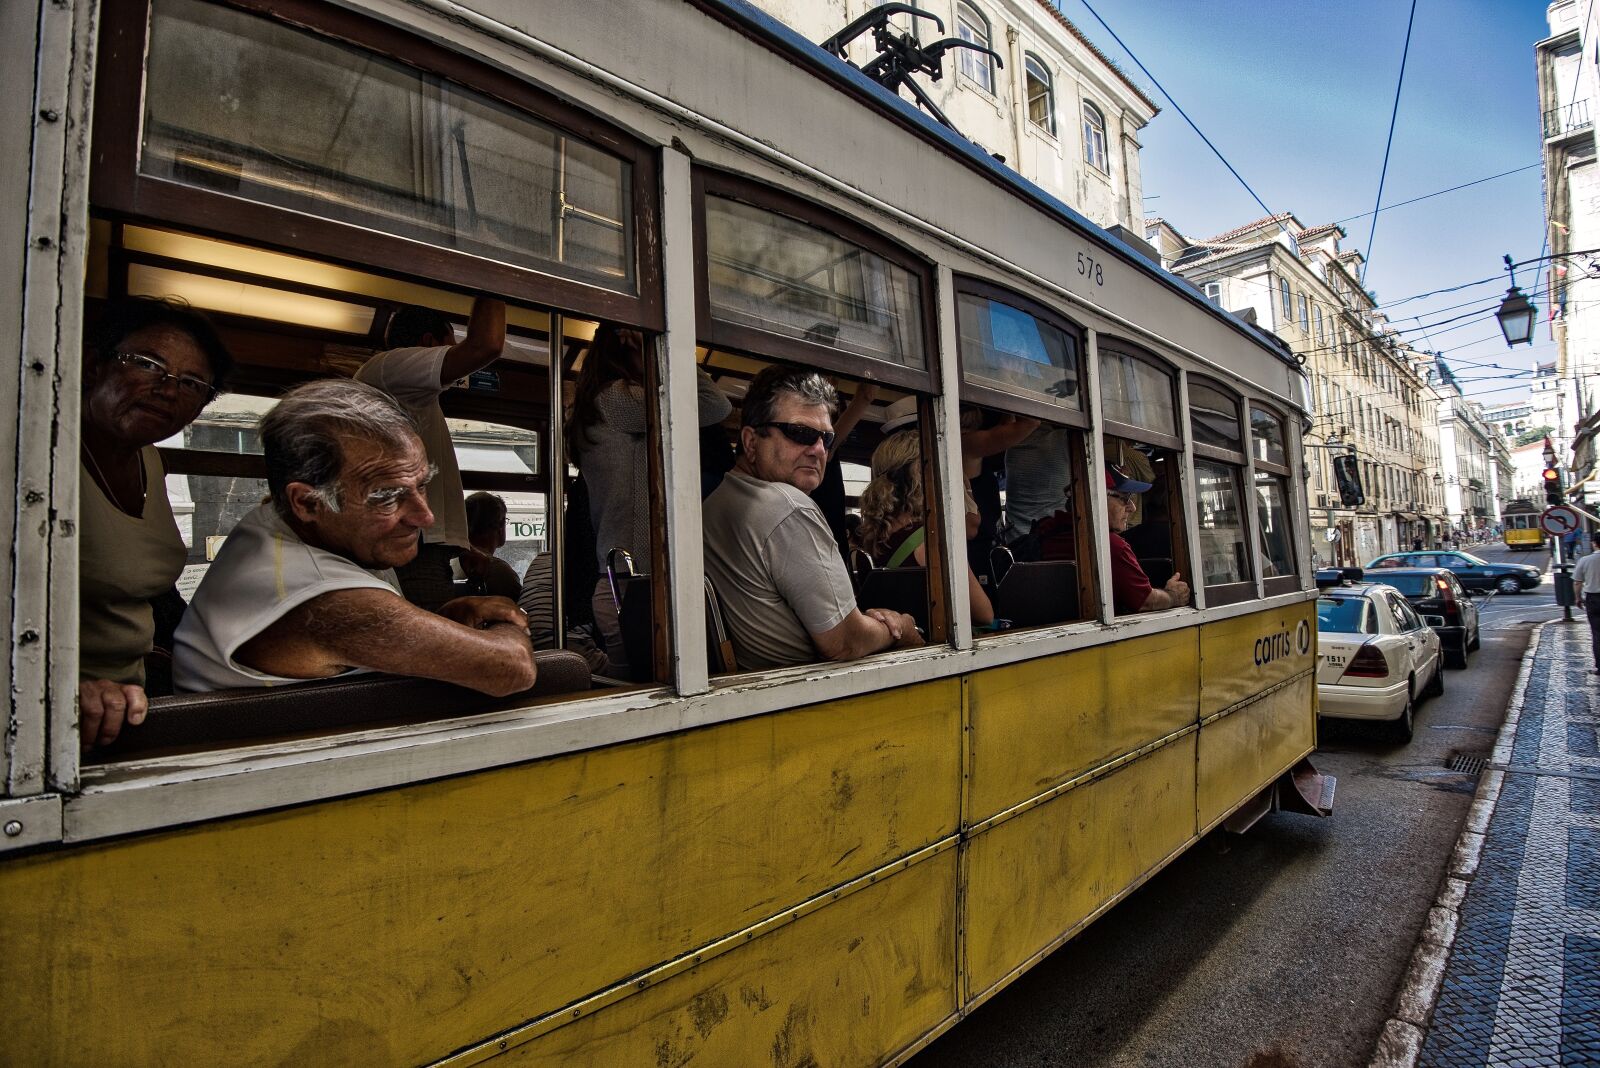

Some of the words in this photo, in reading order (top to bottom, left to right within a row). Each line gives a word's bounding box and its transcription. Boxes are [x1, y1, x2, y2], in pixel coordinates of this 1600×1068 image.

[1077, 251, 1104, 287] 578
[1254, 620, 1290, 667] carris
[1326, 655, 1346, 663] 1511
